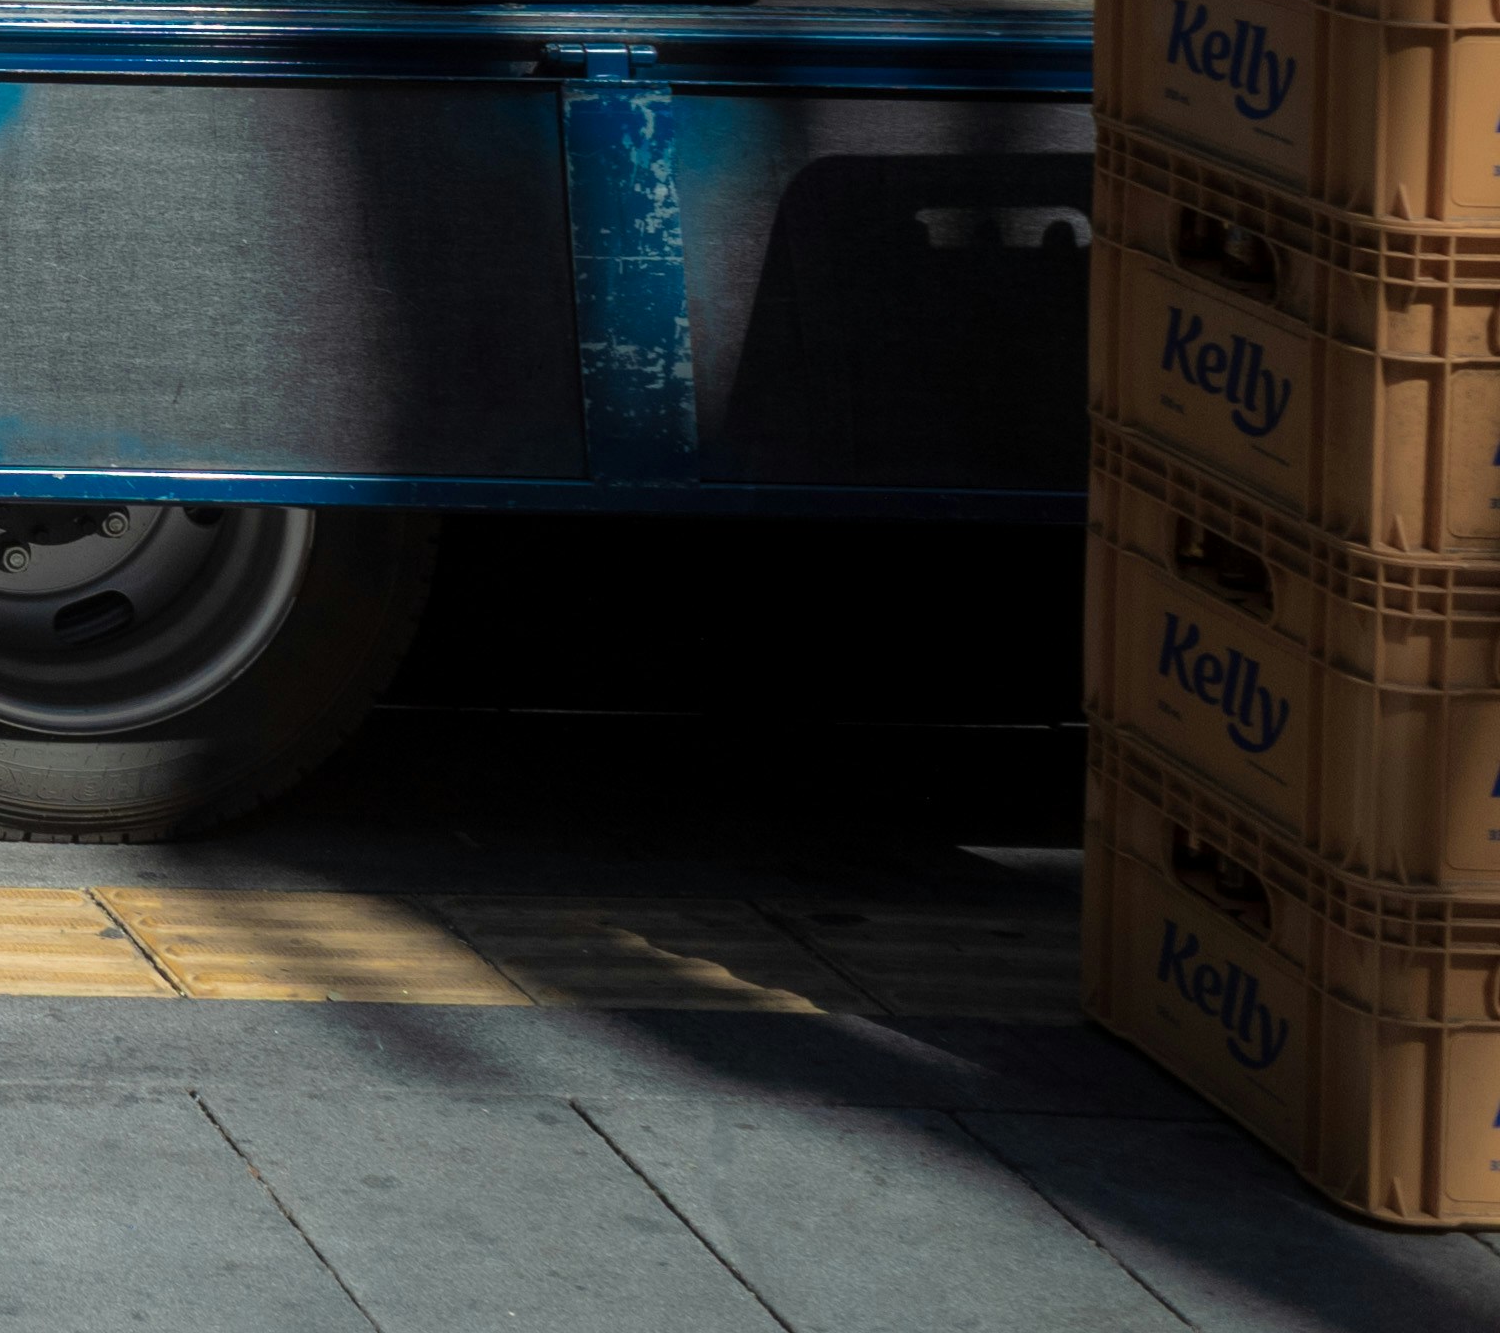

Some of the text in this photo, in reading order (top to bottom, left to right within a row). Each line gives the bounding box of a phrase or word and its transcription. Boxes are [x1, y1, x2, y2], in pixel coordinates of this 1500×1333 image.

[1166, 0, 1297, 121] Kelly
[1161, 305, 1292, 437] Kelly
[1158, 611, 1291, 754] Kelly
[1157, 918, 1290, 1071] Kelly
